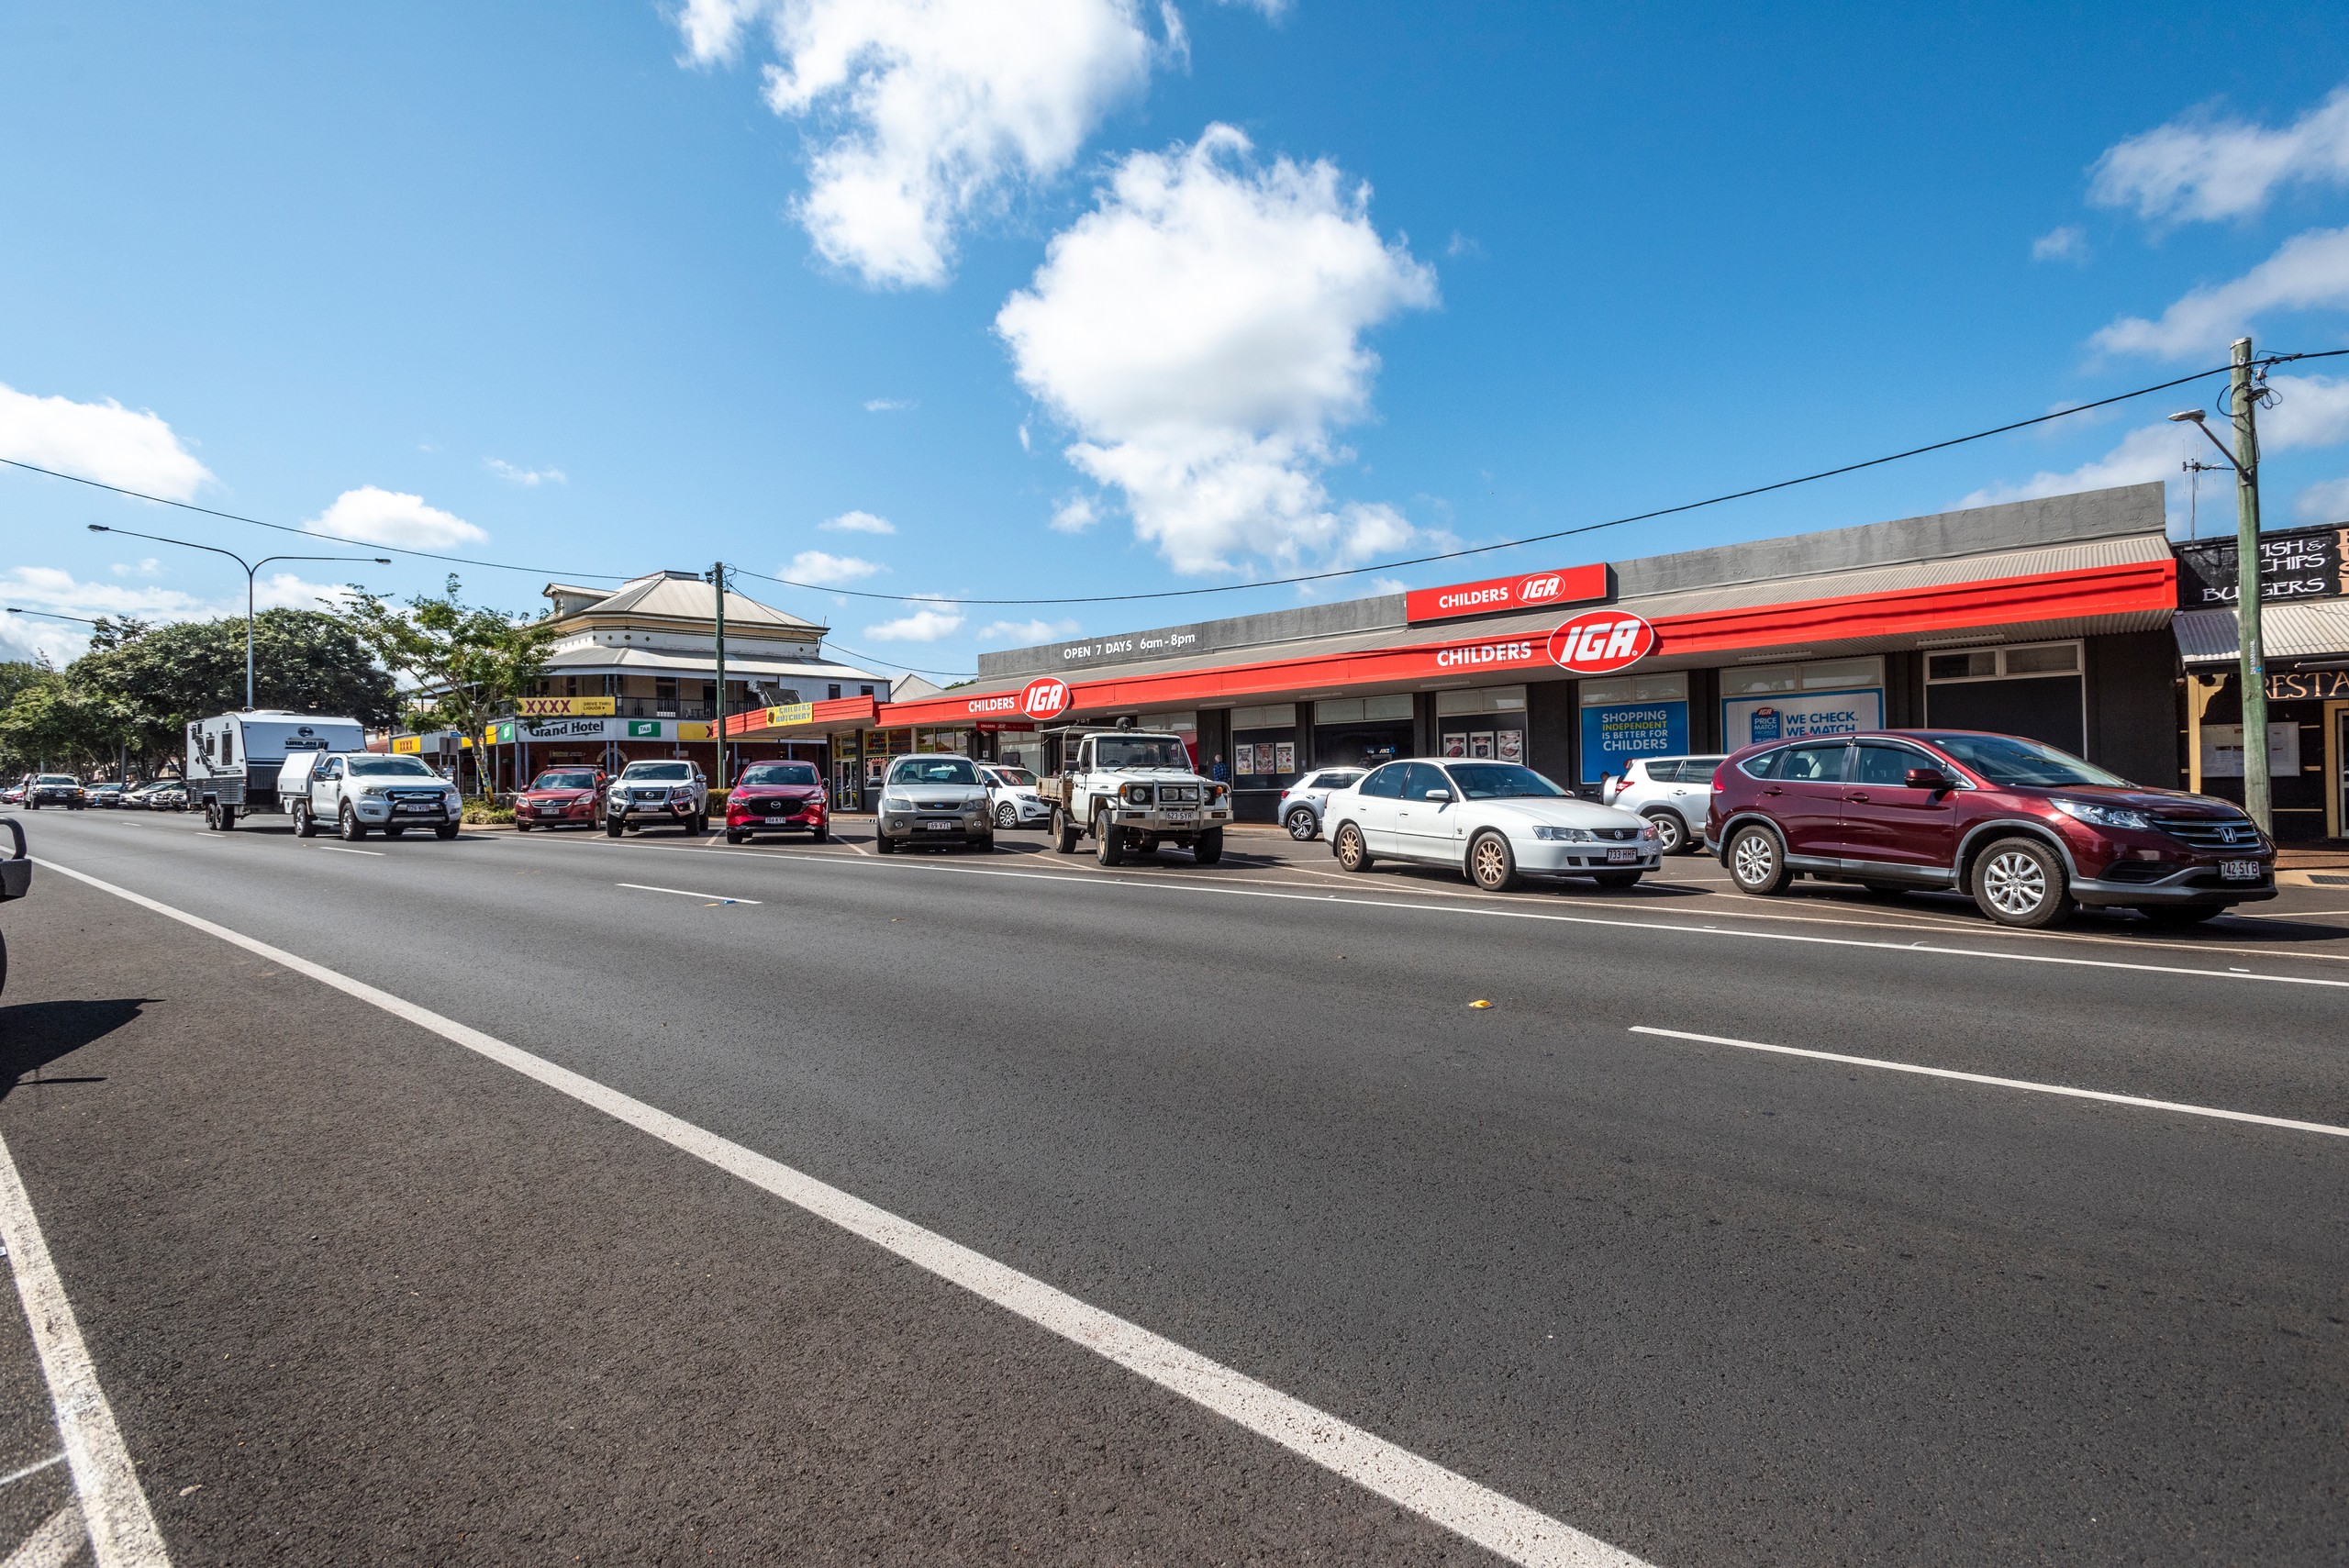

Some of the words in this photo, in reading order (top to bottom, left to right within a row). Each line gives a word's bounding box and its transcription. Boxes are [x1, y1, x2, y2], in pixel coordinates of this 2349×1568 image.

[2306, 540, 2326, 551] &
[1439, 587, 1508, 608] CHILDERS
[1522, 577, 1559, 599] IGA
[2202, 577, 2325, 602] BUGERS
[1063, 646, 1091, 660] OPEN
[1096, 644, 1103, 656] 7
[1106, 639, 1132, 654] DAYS
[1437, 642, 1531, 667] CHILDERS
[1559, 619, 1642, 663] IGA
[968, 697, 1015, 713] CHILDERS
[1025, 684, 1063, 713] IGA
[526, 699, 571, 714] XXXX
[779, 704, 810, 714] CHILDERS
[775, 712, 810, 723] BUTCHERY
[1601, 710, 1667, 723] SHOPPING
[1786, 714, 1806, 725] WE
[1809, 711, 1859, 723] CHECK.
[530, 723, 568, 737] Grand
[571, 720, 604, 733] Hotel
[1602, 720, 1667, 731] INDEPENDENT
[1786, 727, 1806, 737] WE
[1809, 724, 1855, 735] MATCH
[1602, 731, 1610, 740] IS
[1613, 730, 1646, 740] BETTER
[1649, 729, 1668, 738] FOR
[1603, 738, 1668, 751] CHILDERS
